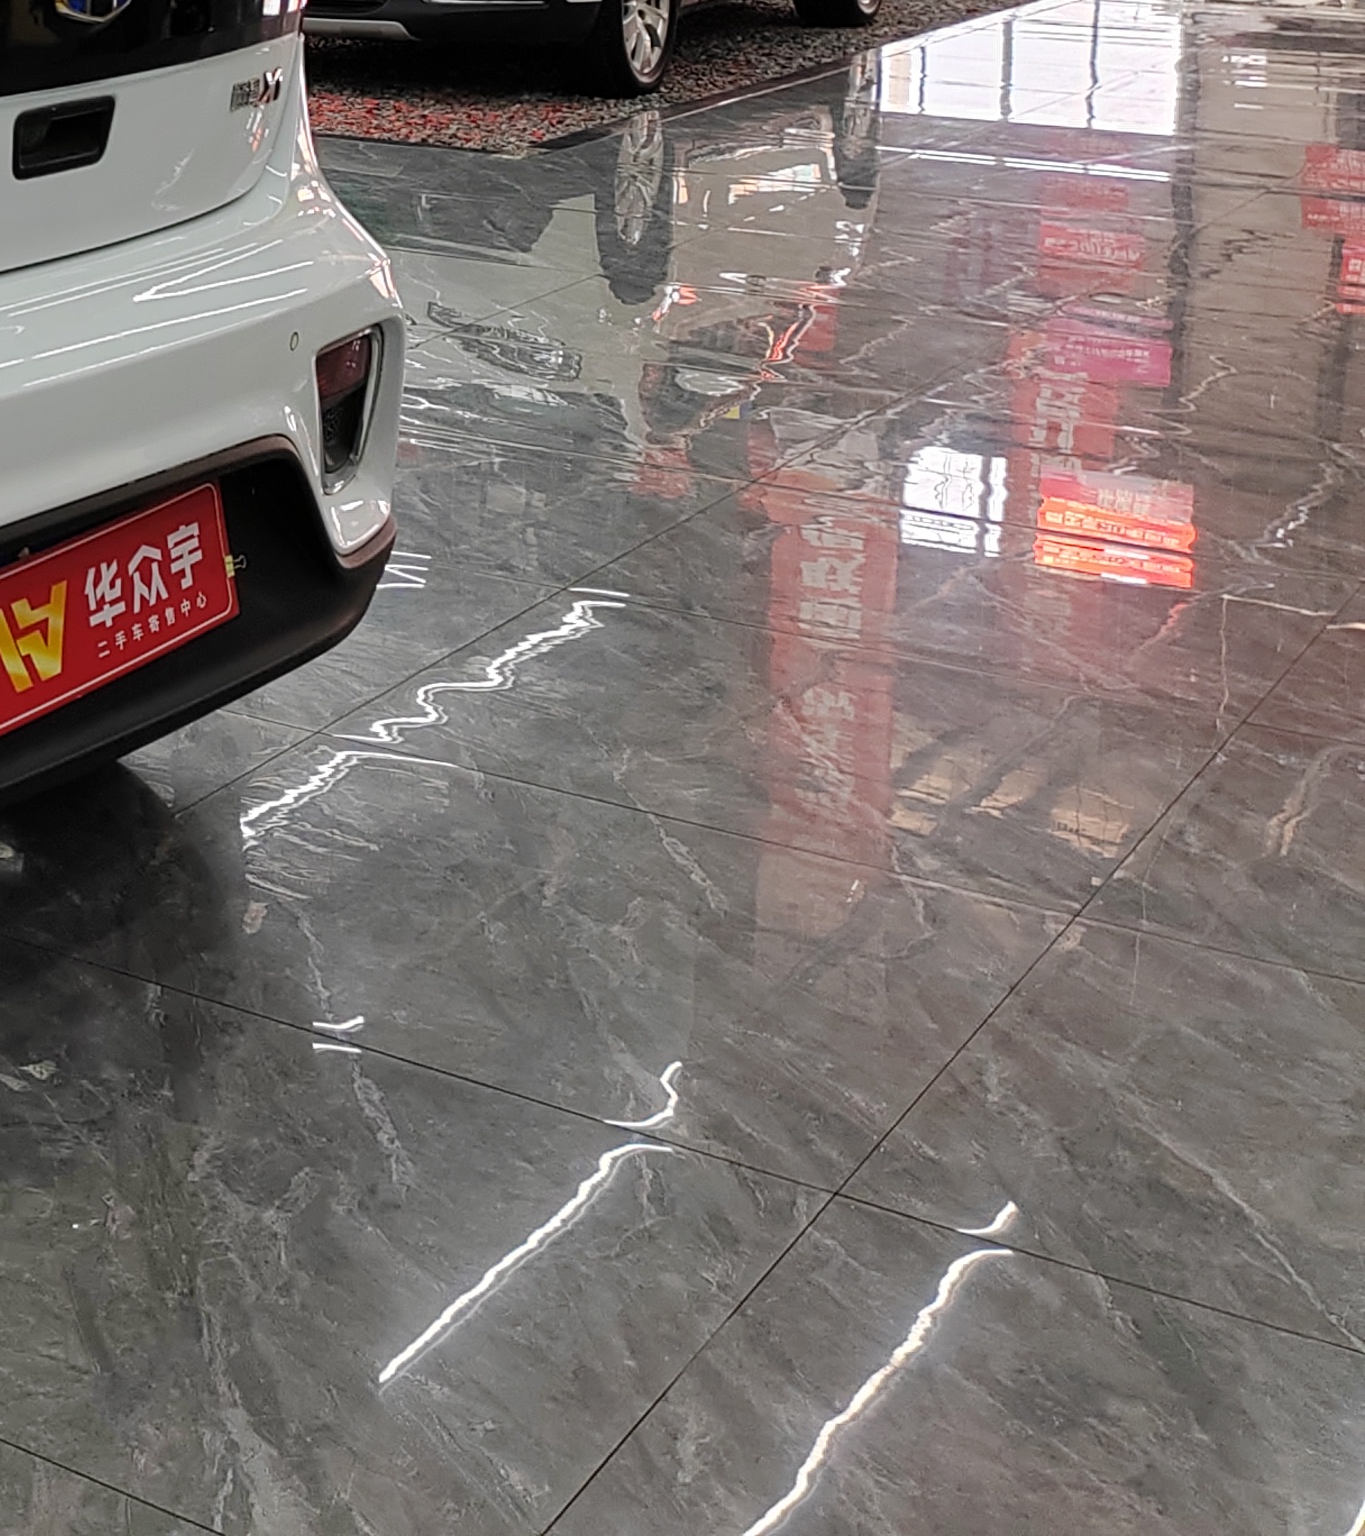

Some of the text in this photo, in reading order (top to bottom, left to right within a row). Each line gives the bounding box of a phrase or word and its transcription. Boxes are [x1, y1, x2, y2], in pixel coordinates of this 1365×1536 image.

[84, 522, 203, 628] 华众宇
[97, 592, 207, 658] 二手车寄售中心
